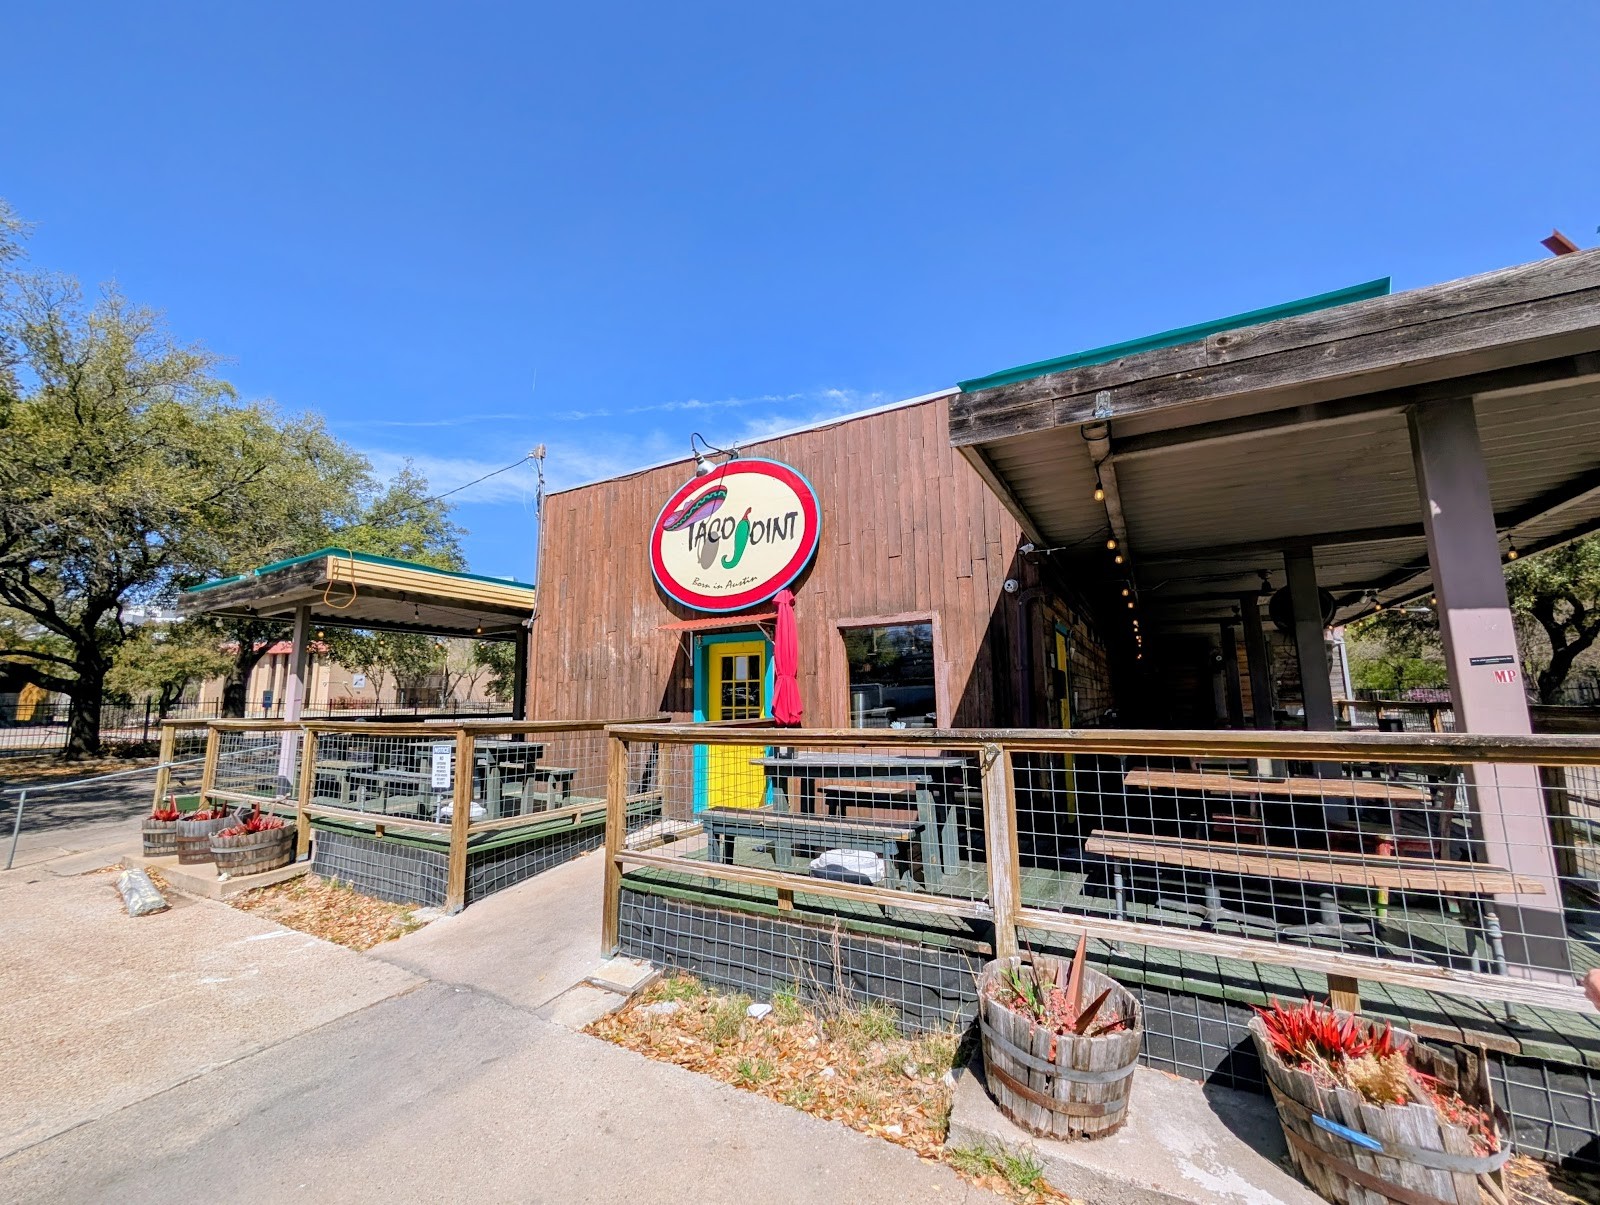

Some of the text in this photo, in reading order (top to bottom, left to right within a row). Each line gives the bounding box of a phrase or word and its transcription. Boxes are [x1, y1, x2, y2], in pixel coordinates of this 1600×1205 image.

[688, 515, 736, 552] TACO
[692, 577, 710, 589] Born
[725, 576, 758, 589] Austin
[1494, 670, 1516, 683] MP
